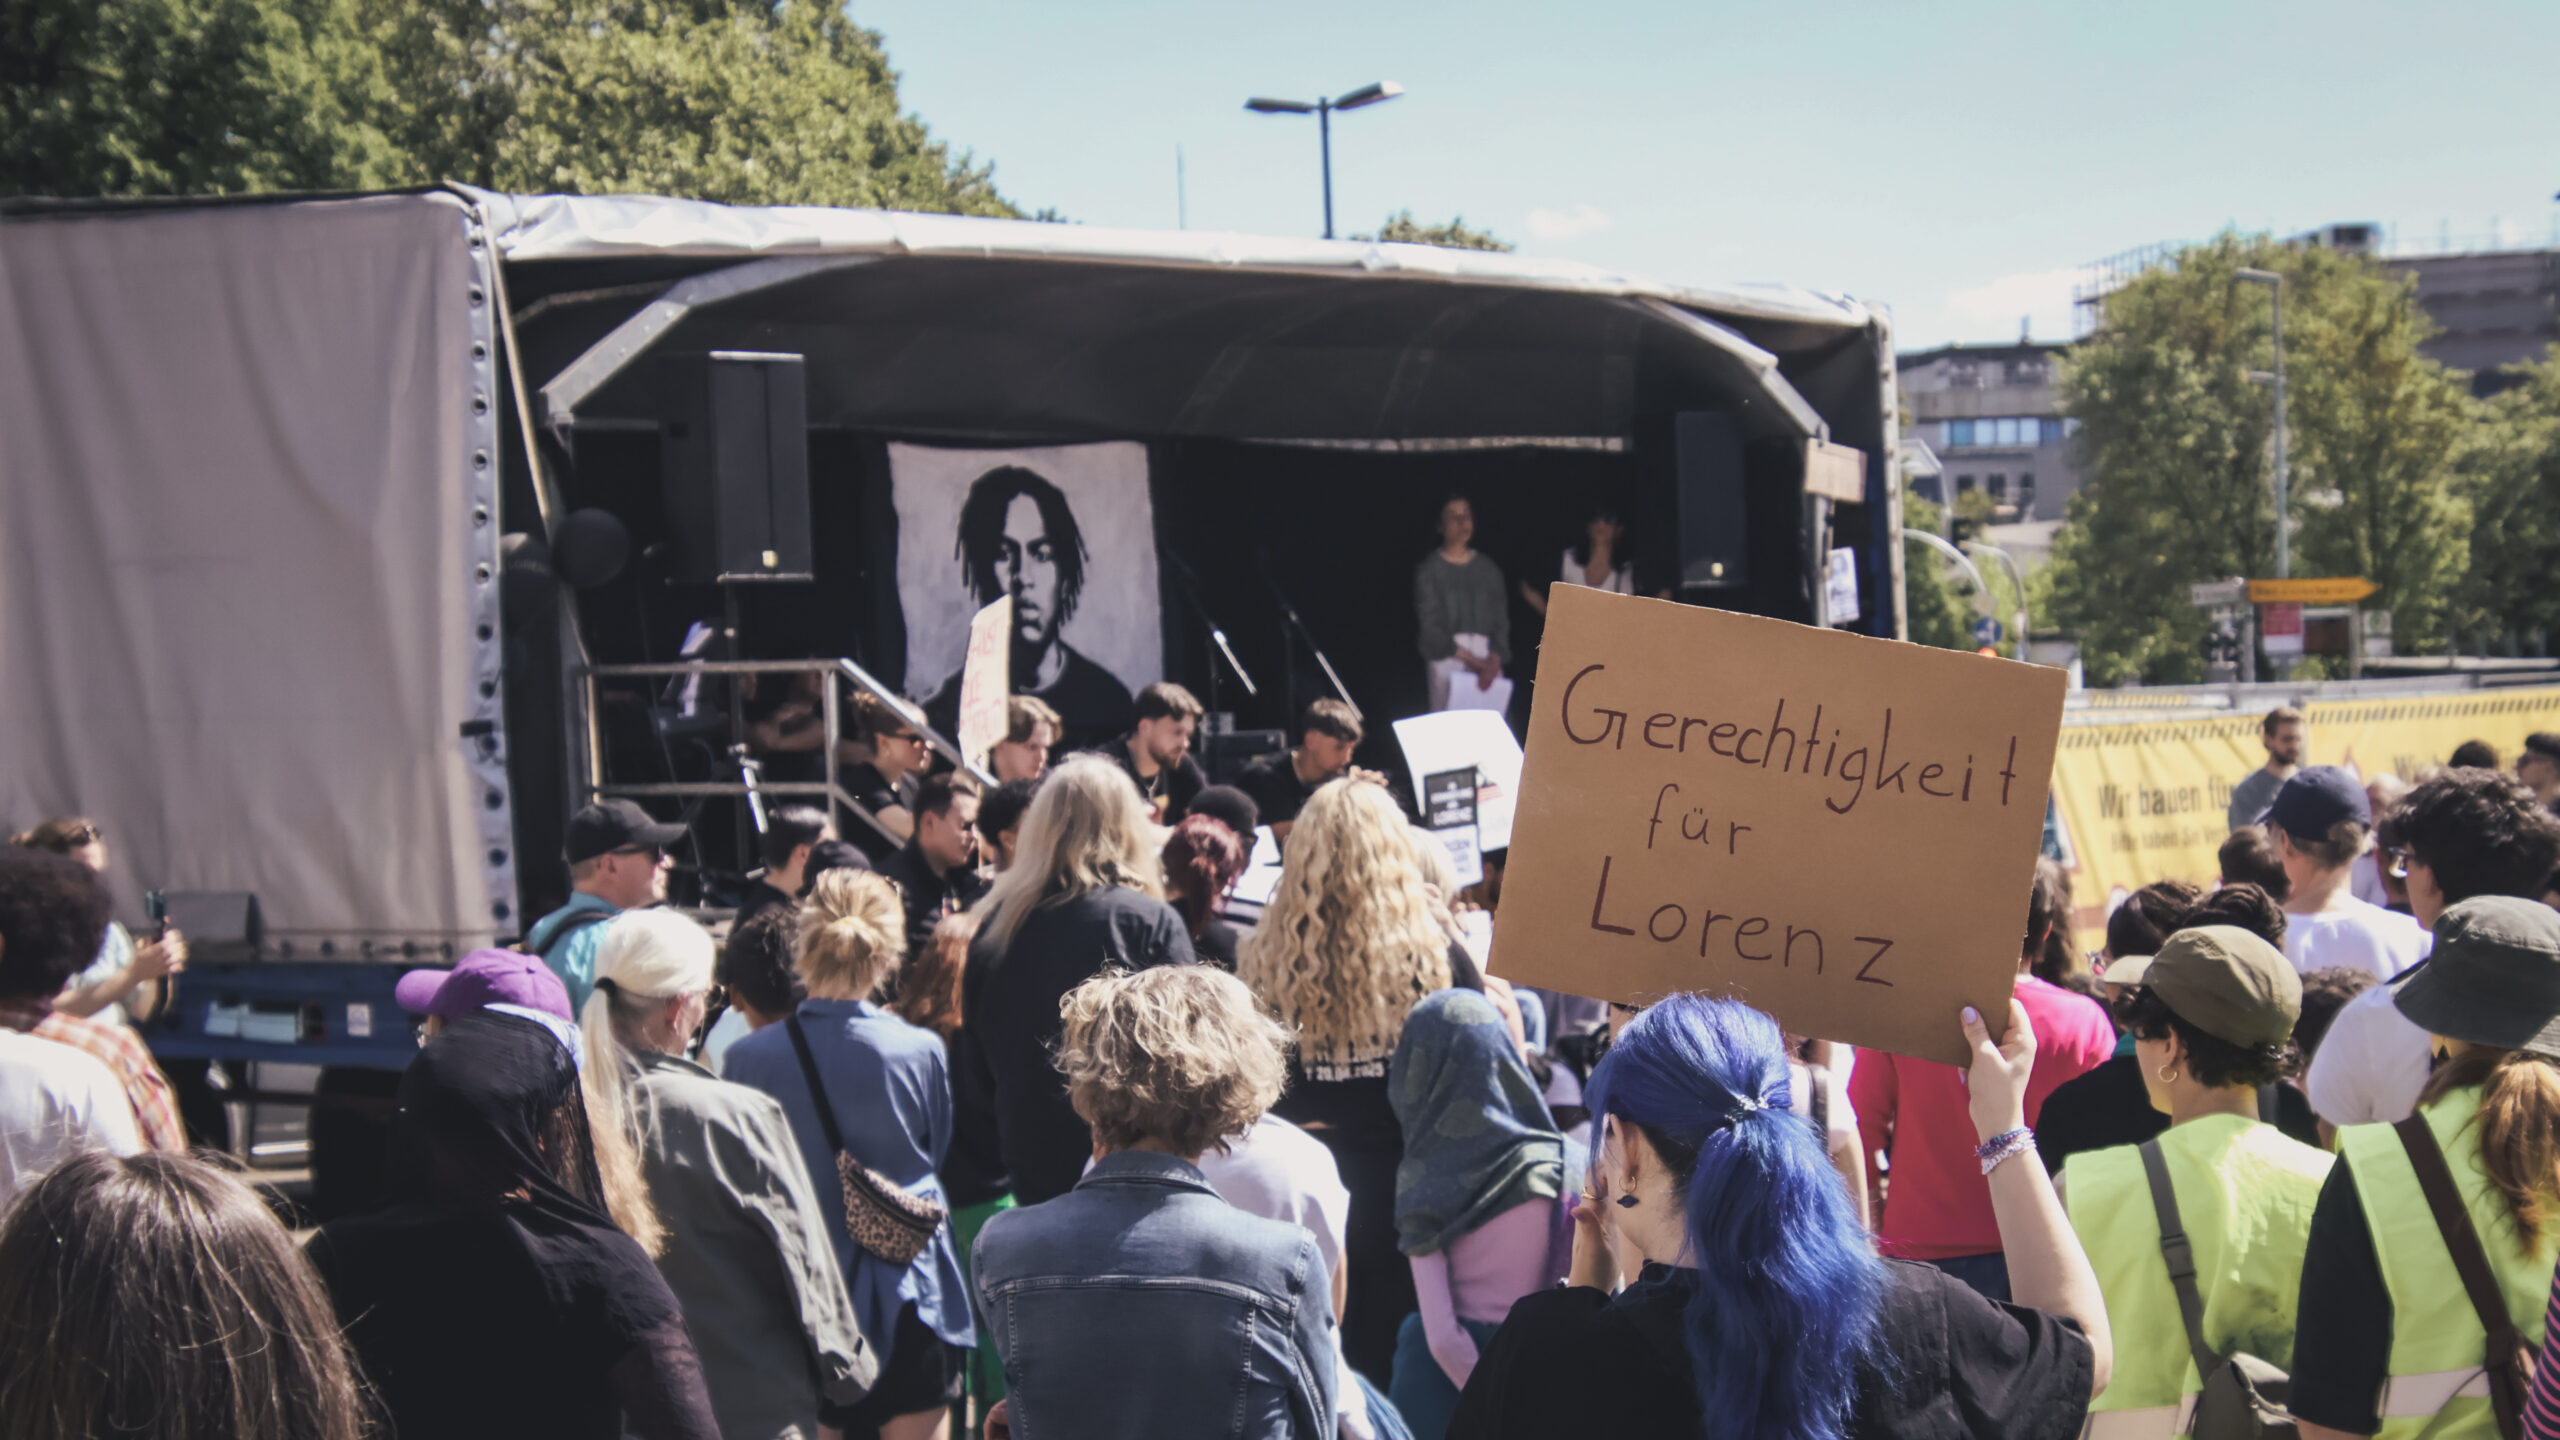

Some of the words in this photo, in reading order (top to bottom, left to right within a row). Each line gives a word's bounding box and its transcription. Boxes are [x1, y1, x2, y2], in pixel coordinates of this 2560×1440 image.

[1562, 664, 2016, 814] Gerechtigkeit
[1648, 783, 1752, 855] für
[2098, 784, 2130, 818] Wir
[2138, 782, 2201, 816] bauen
[1591, 856, 1894, 987] Lorenz
